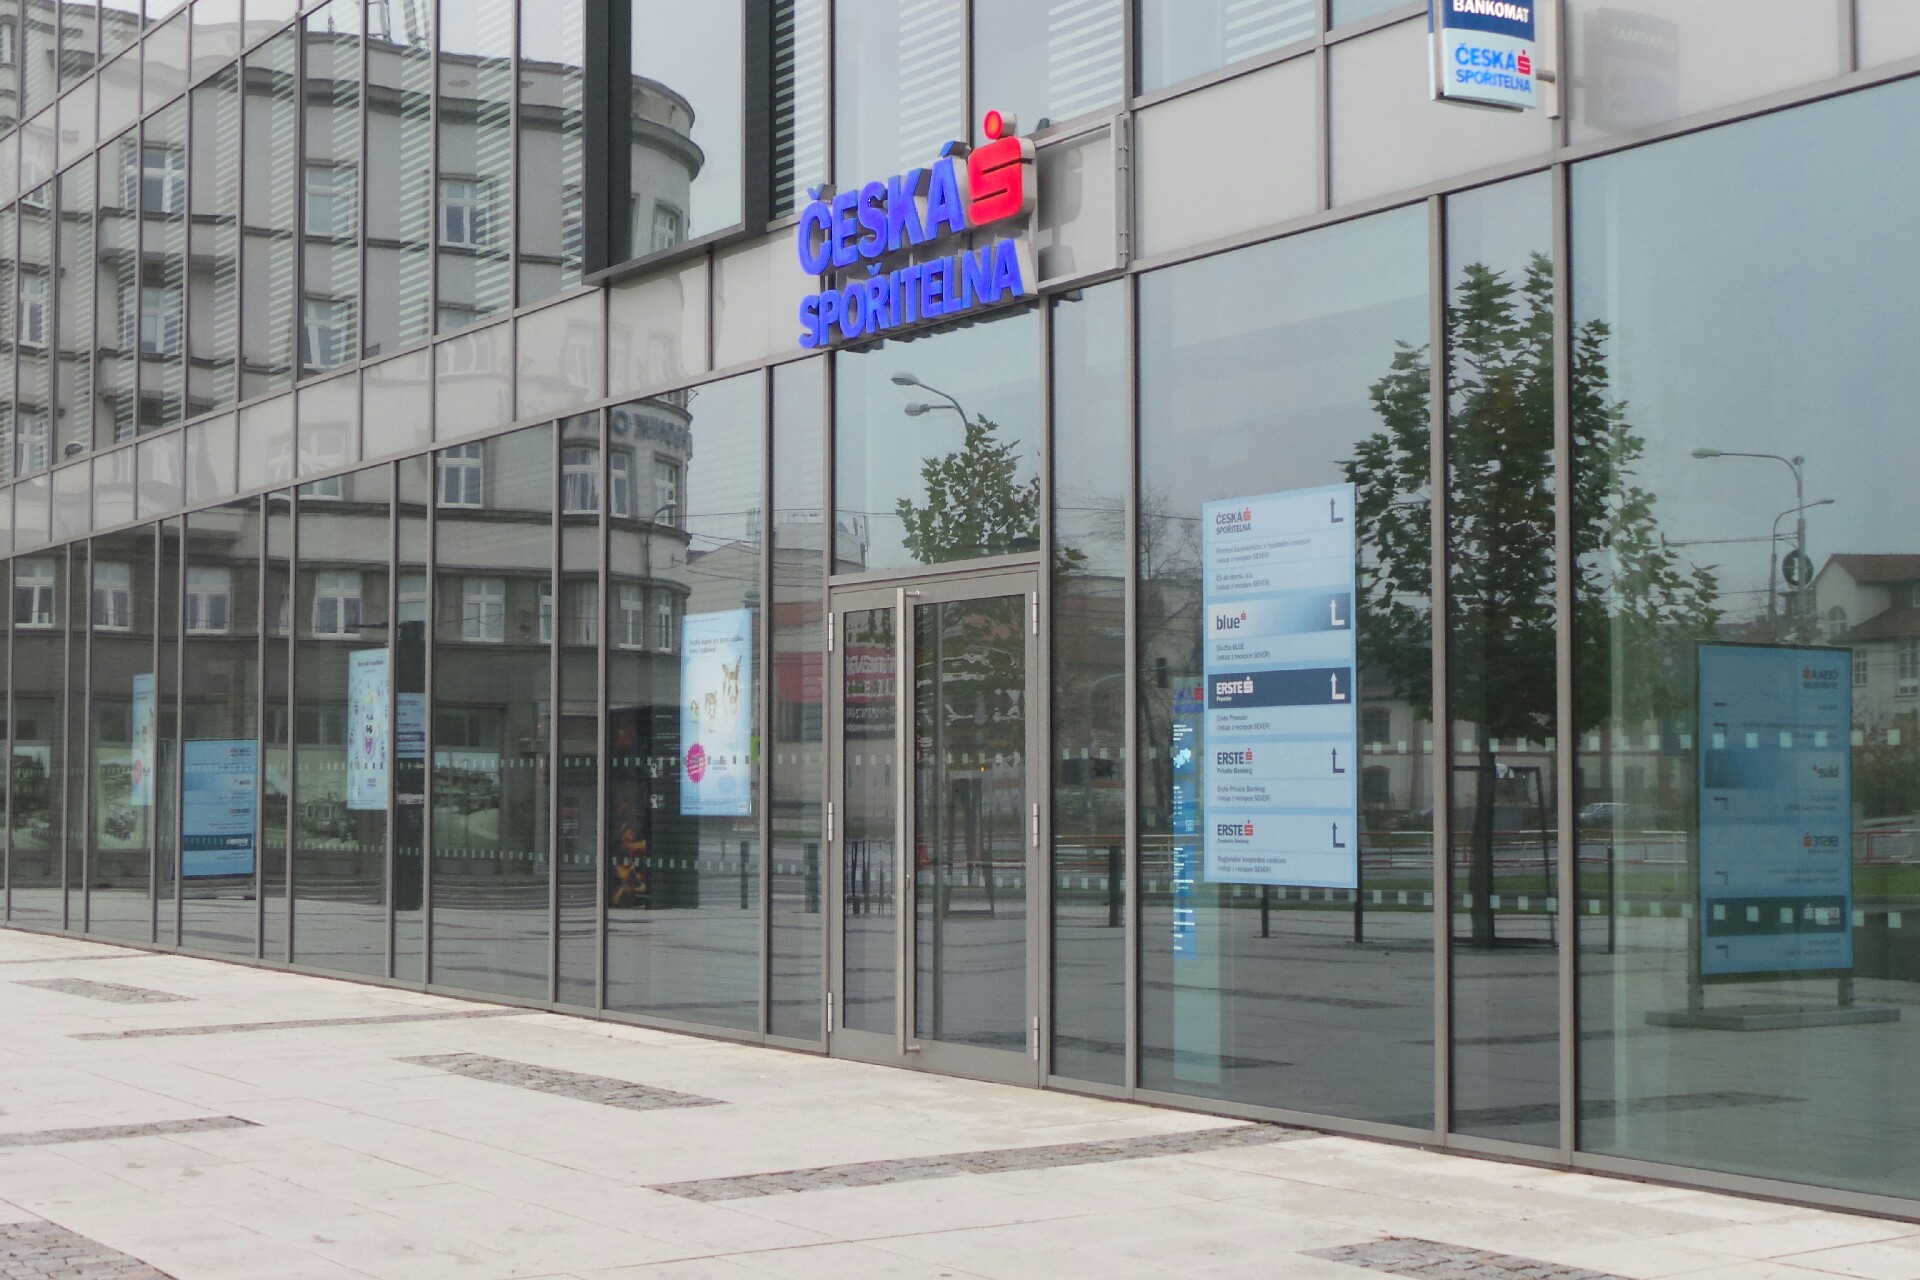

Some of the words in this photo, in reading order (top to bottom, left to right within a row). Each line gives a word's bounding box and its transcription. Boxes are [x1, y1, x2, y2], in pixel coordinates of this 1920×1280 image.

[1453, 0, 1529, 23] BANKOMAT
[1455, 43, 1516, 71] ČESKÁ
[1456, 69, 1531, 93] SPOŘITELNA
[798, 140, 966, 276] ČESKÁ
[798, 238, 1024, 349] SPOŘITELNA
[1216, 510, 1242, 525] ČESKÁ
[1216, 613, 1240, 630] blue
[1233, 643, 1244, 651] BLUE
[1216, 681, 1242, 695] ERSTE
[1217, 752, 1244, 765] ERSTE
[1217, 785, 1228, 793] Erste
[1230, 785, 1245, 793] Private
[1246, 786, 1265, 794] Banking
[1217, 825, 1243, 836] ERSTE
